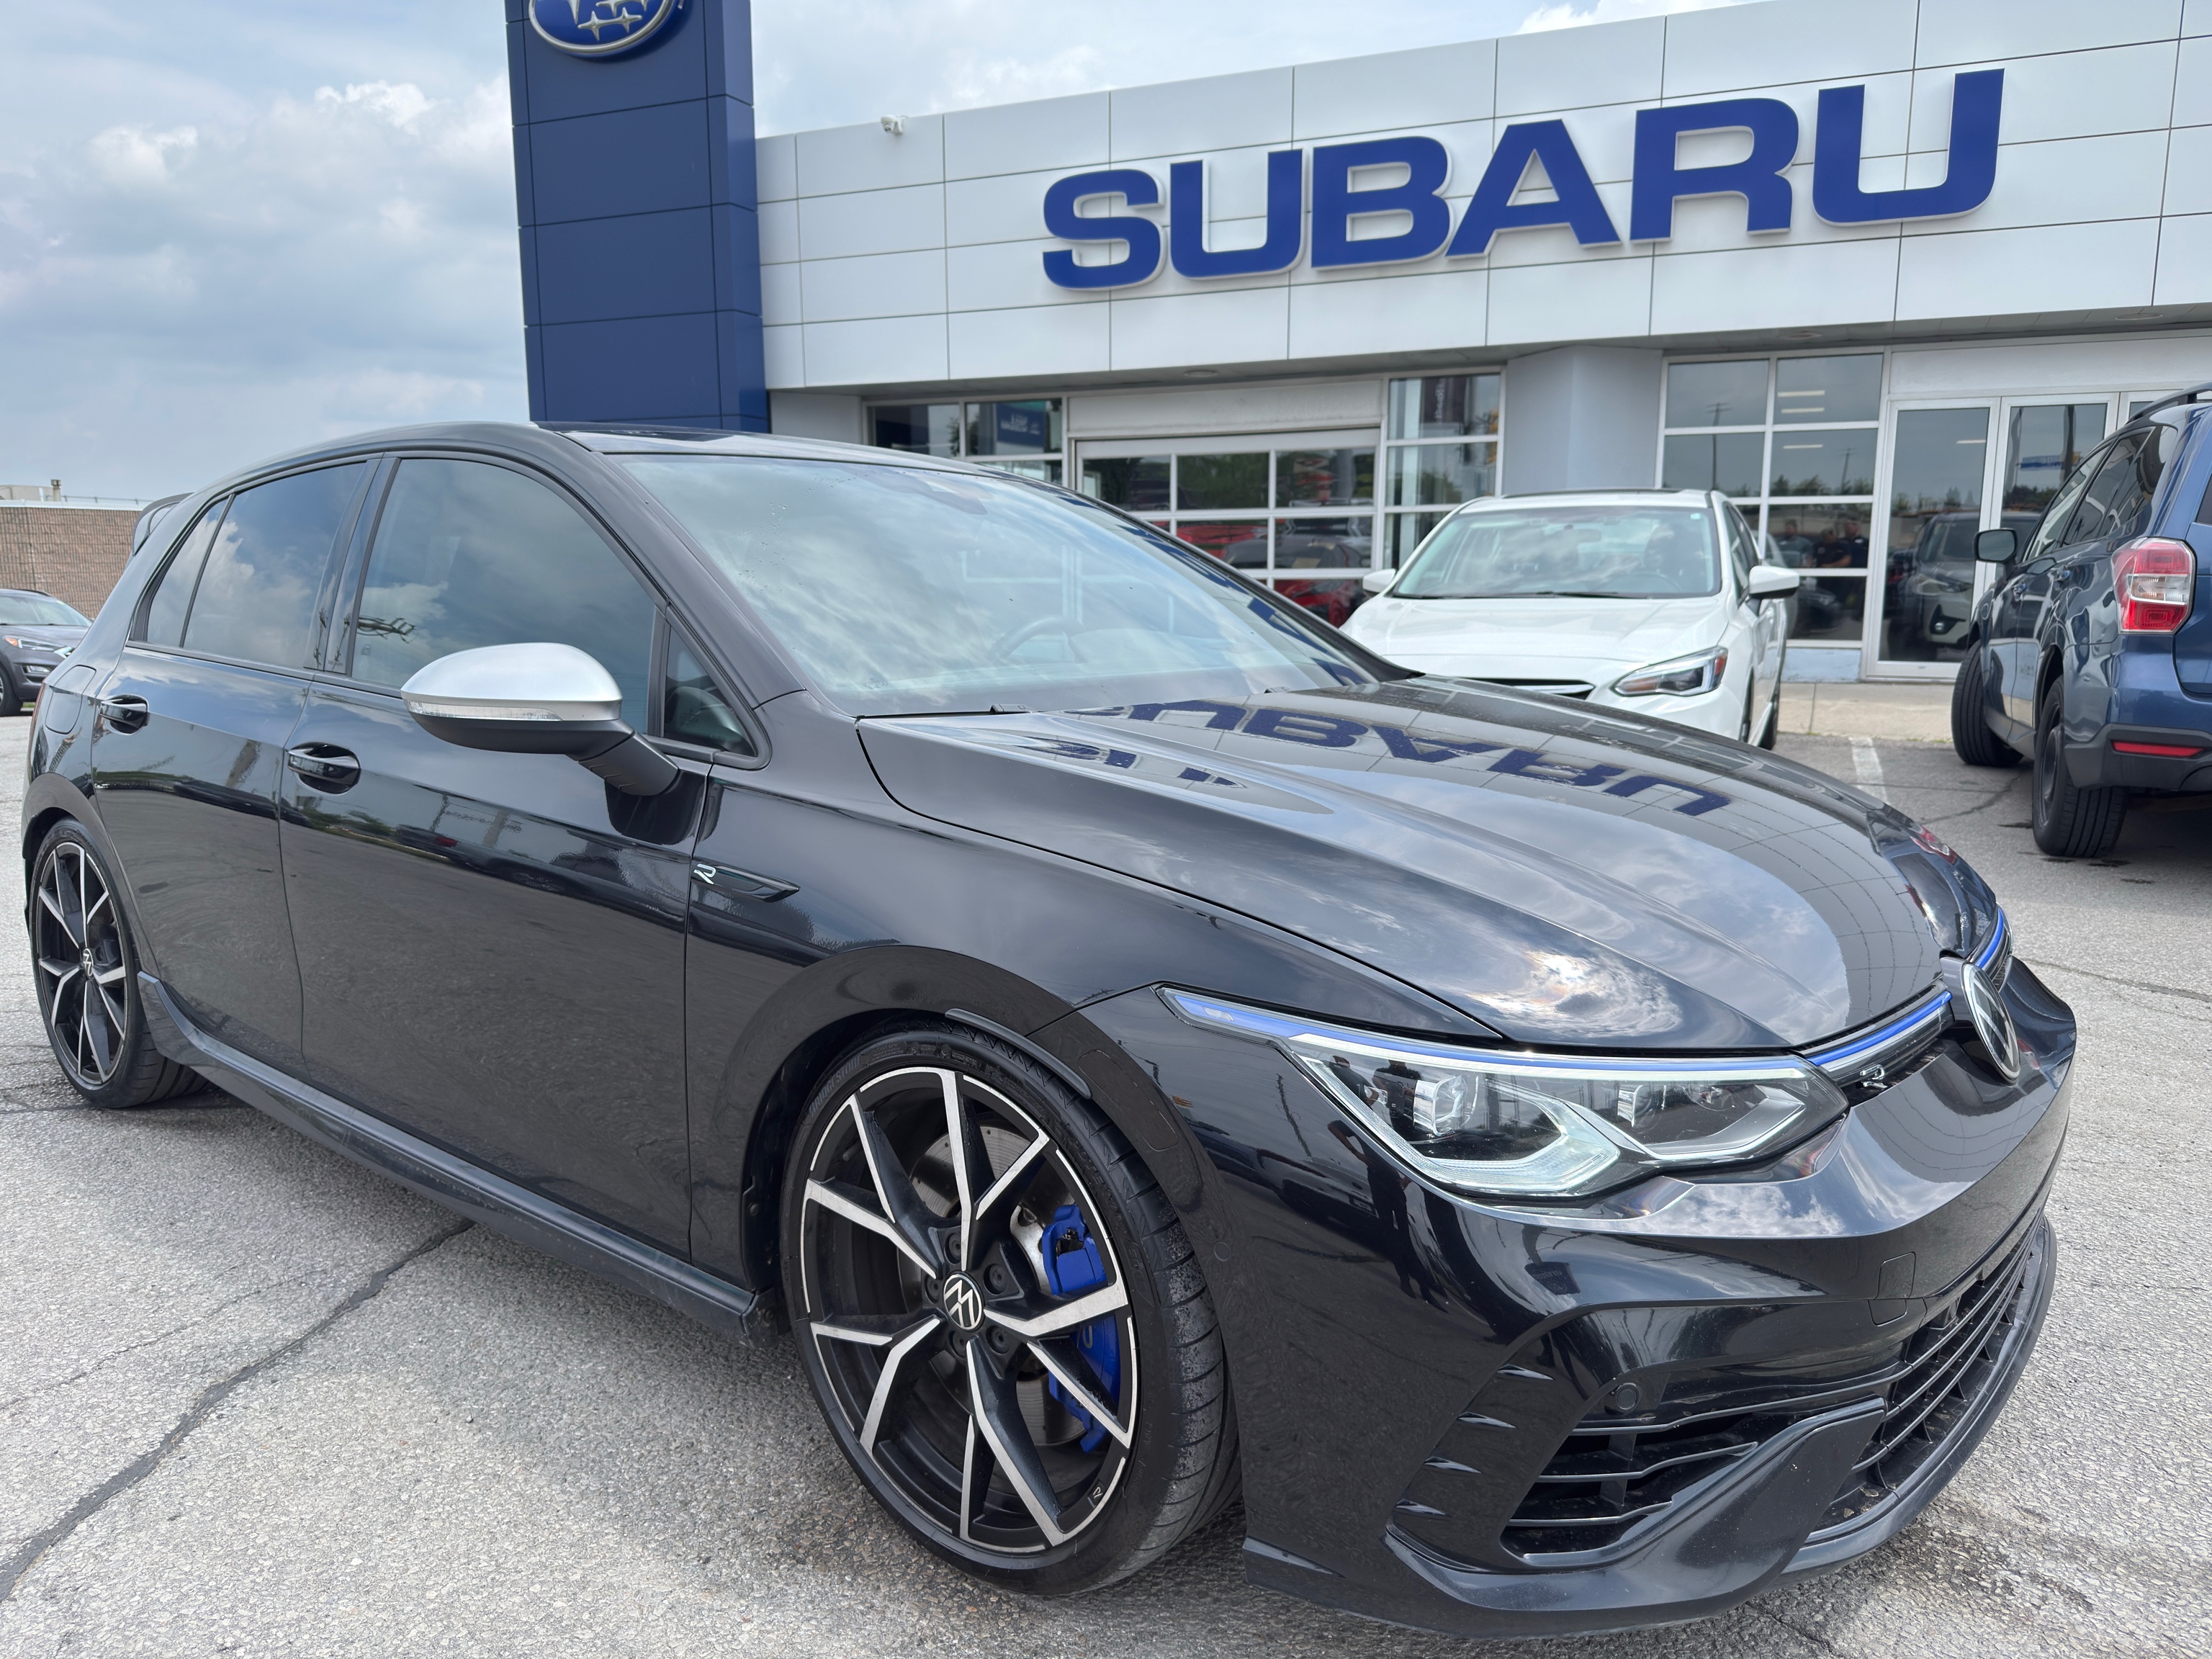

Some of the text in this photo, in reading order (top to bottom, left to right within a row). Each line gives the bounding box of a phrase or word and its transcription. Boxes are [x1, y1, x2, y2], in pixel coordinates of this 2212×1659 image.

[1042, 68, 2005, 289] SUBARU
[693, 863, 716, 885] R
[1859, 1064, 1887, 1089] R
